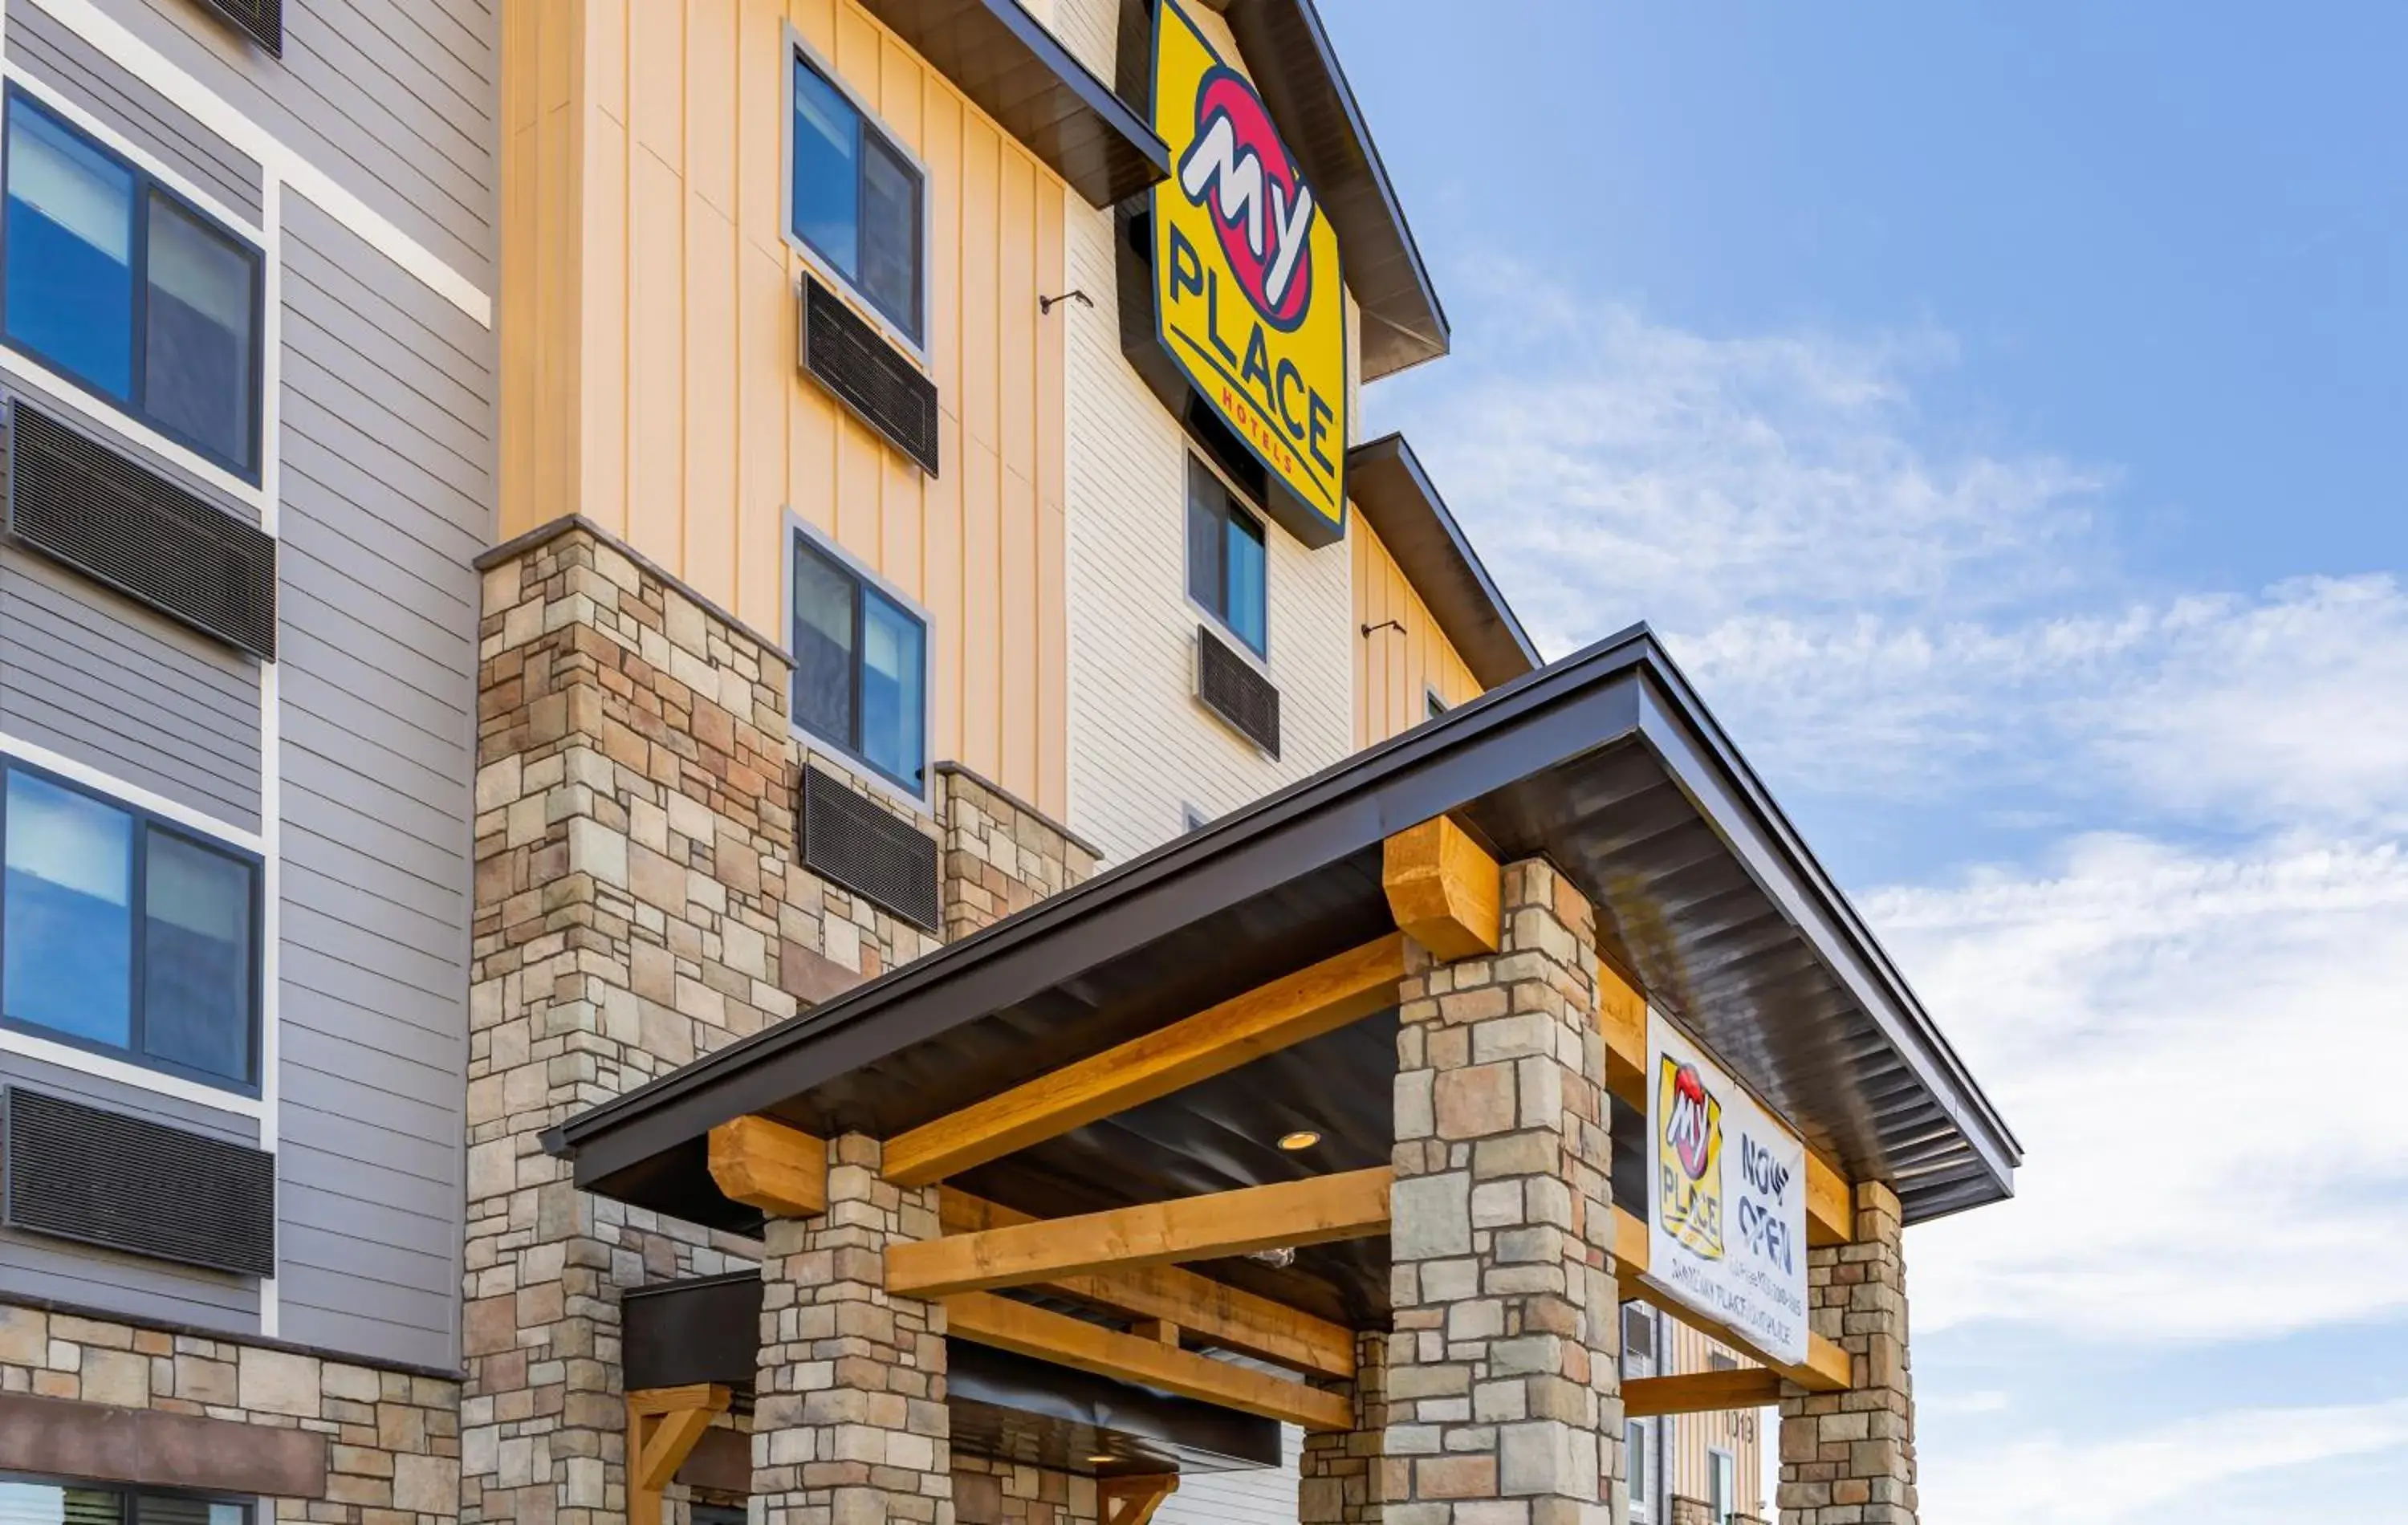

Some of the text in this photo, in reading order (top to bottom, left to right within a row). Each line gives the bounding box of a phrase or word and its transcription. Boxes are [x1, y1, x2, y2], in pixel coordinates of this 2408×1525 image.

[1169, 221, 1336, 478] PLACE
[1222, 386, 1293, 474] HOTELS
[1663, 1165, 1718, 1235] PLACE
[1741, 1131, 1790, 1206] NOW
[1738, 1195, 1792, 1275] OPEN
